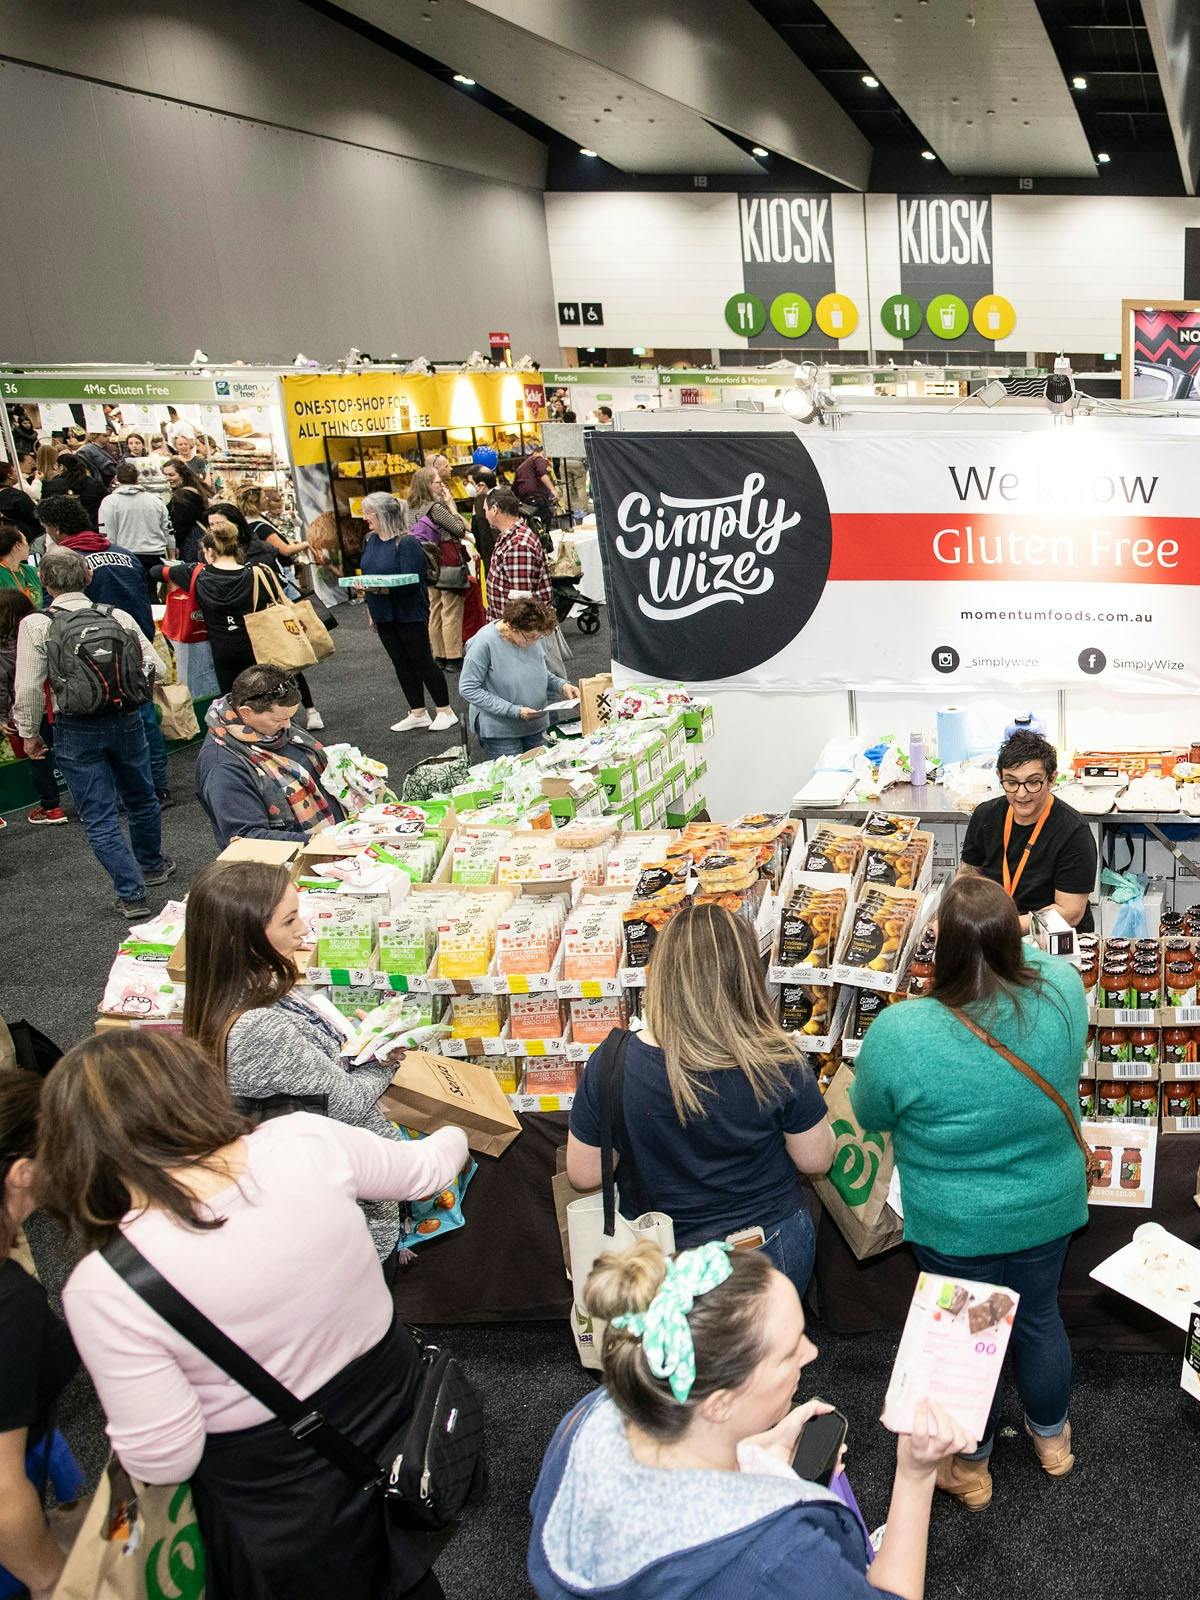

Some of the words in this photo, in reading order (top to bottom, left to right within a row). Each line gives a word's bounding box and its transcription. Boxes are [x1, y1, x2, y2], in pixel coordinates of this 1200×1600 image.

[1019, 178, 1034, 189] 19
[740, 198, 832, 264] KIOSK
[900, 199, 991, 265] KIOSK
[554, 374, 577, 383] Foodini
[705, 376, 740, 384] Rutherford
[741, 376, 747, 384] &
[748, 376, 768, 385] Meyer
[4, 383, 18, 394] 36
[83, 384, 106, 395] 4Me
[108, 384, 144, 396] Gluten
[147, 385, 170, 396] Free
[233, 383, 258, 393] gluten
[239, 390, 256, 398] free
[294, 397, 385, 416] ONE-STOP-SHOP
[298, 423, 320, 439] ALL
[320, 418, 364, 438] THINGS
[949, 465, 1020, 503] We
[616, 472, 800, 560] Simply
[932, 524, 1079, 568] Gluten
[1088, 530, 1180, 570] Free
[86, 551, 133, 569] ICTORY
[960, 608, 1153, 624] momentumfoods.com.au
[1112, 657, 1185, 673] SimplyWize
